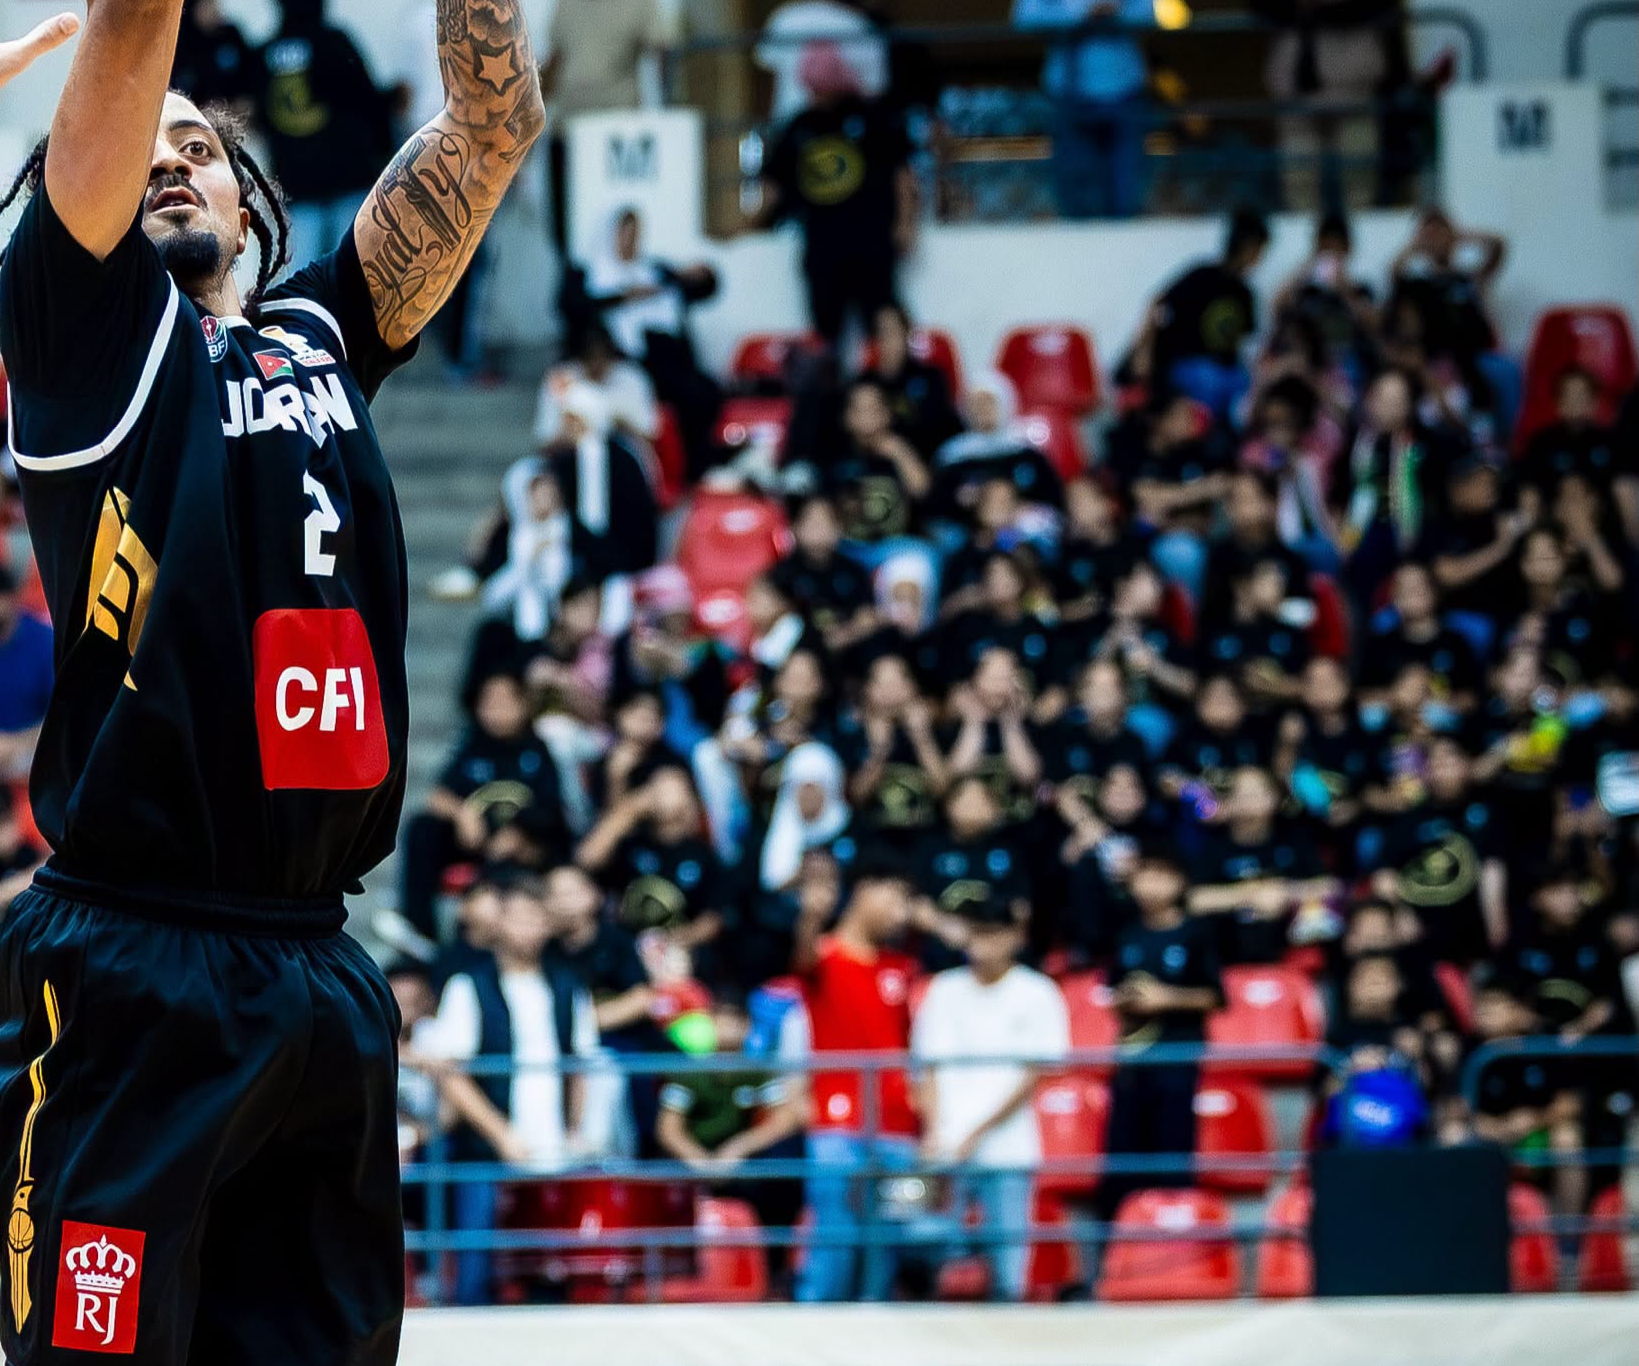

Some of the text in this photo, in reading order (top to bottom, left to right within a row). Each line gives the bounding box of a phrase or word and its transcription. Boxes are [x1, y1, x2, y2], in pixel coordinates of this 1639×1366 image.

[303, 469, 341, 577] 2
[275, 666, 365, 732] CFI
[75, 1292, 119, 1346] RJ
